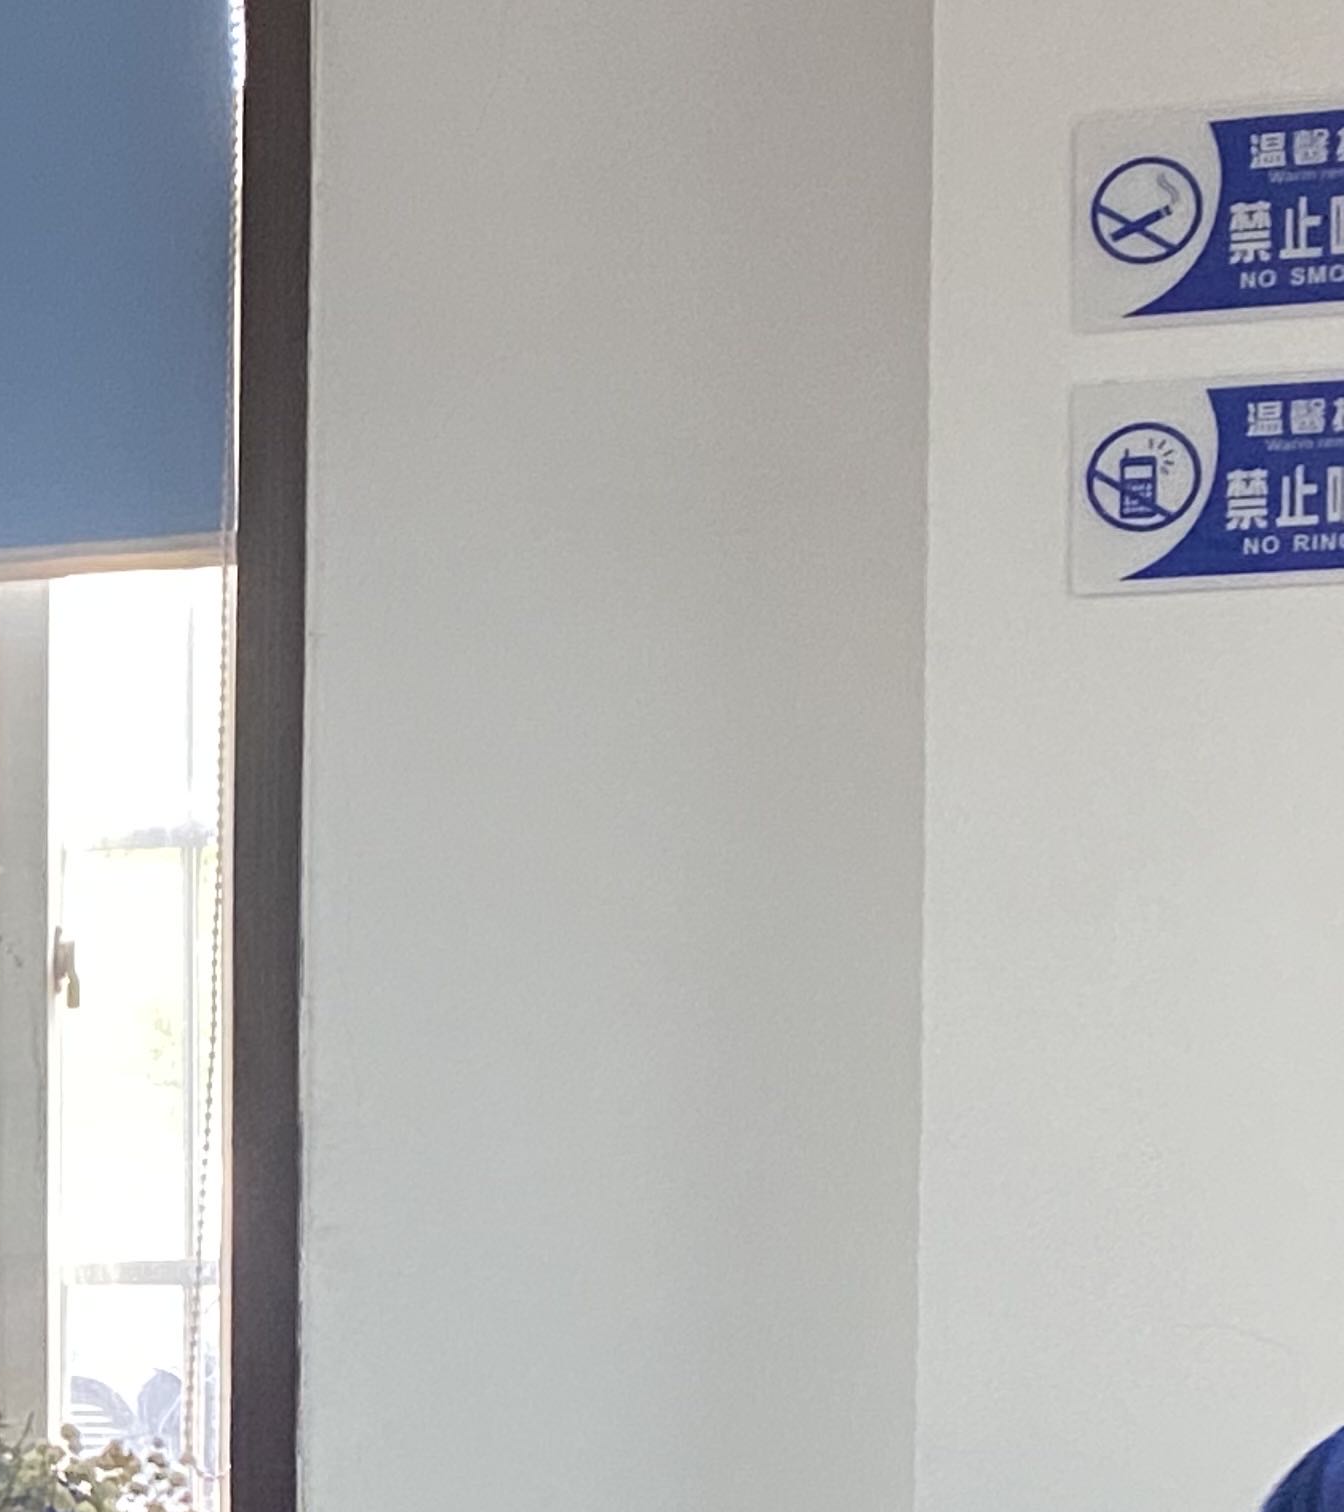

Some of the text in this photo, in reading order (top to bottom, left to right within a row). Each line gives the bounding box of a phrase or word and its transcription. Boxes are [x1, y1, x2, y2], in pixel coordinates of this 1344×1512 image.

[1249, 128, 1344, 169] 温馨
[1240, 269, 1276, 289] NO
[1246, 397, 1344, 437] 温馨
[1243, 532, 1344, 555] NO RIN
